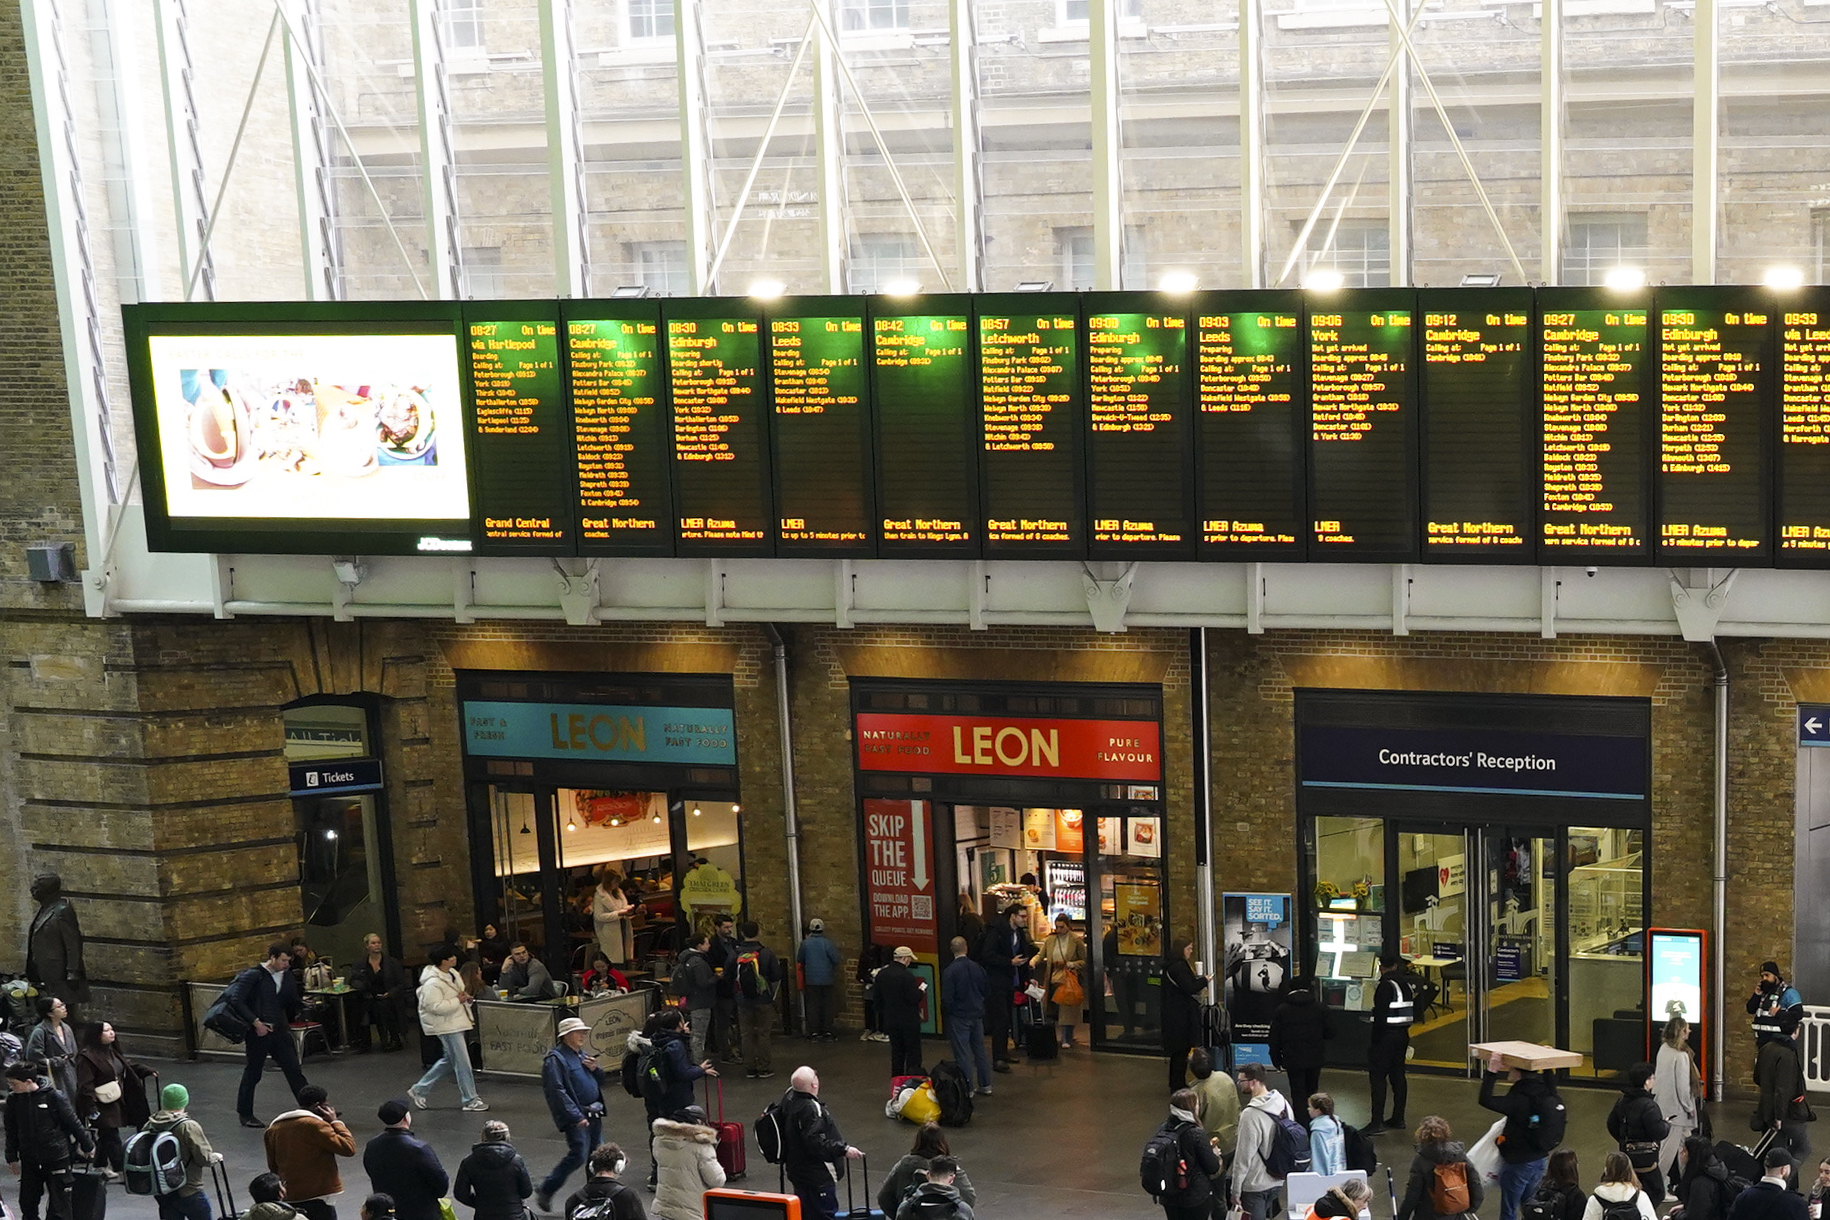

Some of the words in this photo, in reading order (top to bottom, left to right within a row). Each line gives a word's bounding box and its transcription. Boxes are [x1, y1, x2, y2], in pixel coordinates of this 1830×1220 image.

[981, 319, 1009, 329] 08:57
[1089, 318, 1118, 328] 09:00
[1199, 317, 1228, 327] 09:03
[1311, 315, 1341, 326] 09:06
[1426, 315, 1456, 326] 09:12
[1544, 314, 1575, 325] 09:27
[1662, 314, 1694, 325] 09:30
[1785, 314, 1817, 325] 09:33
[471, 325, 496, 335] 08:27
[569, 324, 595, 334] 08:27
[669, 323, 696, 333] 08:30
[772, 322, 799, 332] 08:33
[875, 321, 903, 331] 08:42
[982, 334, 1039, 344] Letchworth
[1090, 333, 1139, 343] Edinburgh
[1200, 332, 1230, 342] Leeds
[1312, 331, 1338, 341] York
[1426, 331, 1480, 341] Cambridge
[1544, 330, 1598, 341] Cambridge
[1663, 330, 1717, 341] Edinburgh
[1785, 330, 1800, 340] via
[472, 341, 485, 349] via
[489, 340, 535, 349] Hartlepool
[570, 339, 617, 349] Cambridge
[671, 338, 716, 347] Edinburgh
[773, 337, 801, 346] Leeds
[876, 335, 924, 346] Cambridge
[486, 519, 512, 528] Grand
[516, 519, 550, 528] Central
[550, 713, 646, 752] LEON
[663, 724, 728, 734] NATURALLY
[863, 730, 930, 741] NATURALLY
[665, 737, 691, 747] FAST
[697, 738, 727, 748] FOOD
[953, 726, 1059, 767] LEON
[1109, 738, 1139, 747] PURE
[865, 745, 891, 754] FAST
[898, 745, 929, 755] FOOD
[1097, 752, 1152, 763] FLAVOUR
[1378, 748, 1473, 767] Contractors'
[1476, 752, 1556, 772] Reception
[322, 771, 354, 784] Tickets
[869, 815, 904, 837] SKIP
[870, 840, 906, 868] THE
[872, 870, 907, 887] QUEUE
[873, 894, 908, 904] DOWNLOAD
[874, 904, 890, 917] THE
[892, 906, 911, 919] APP.
[1248, 913, 1281, 921] SORTED.
